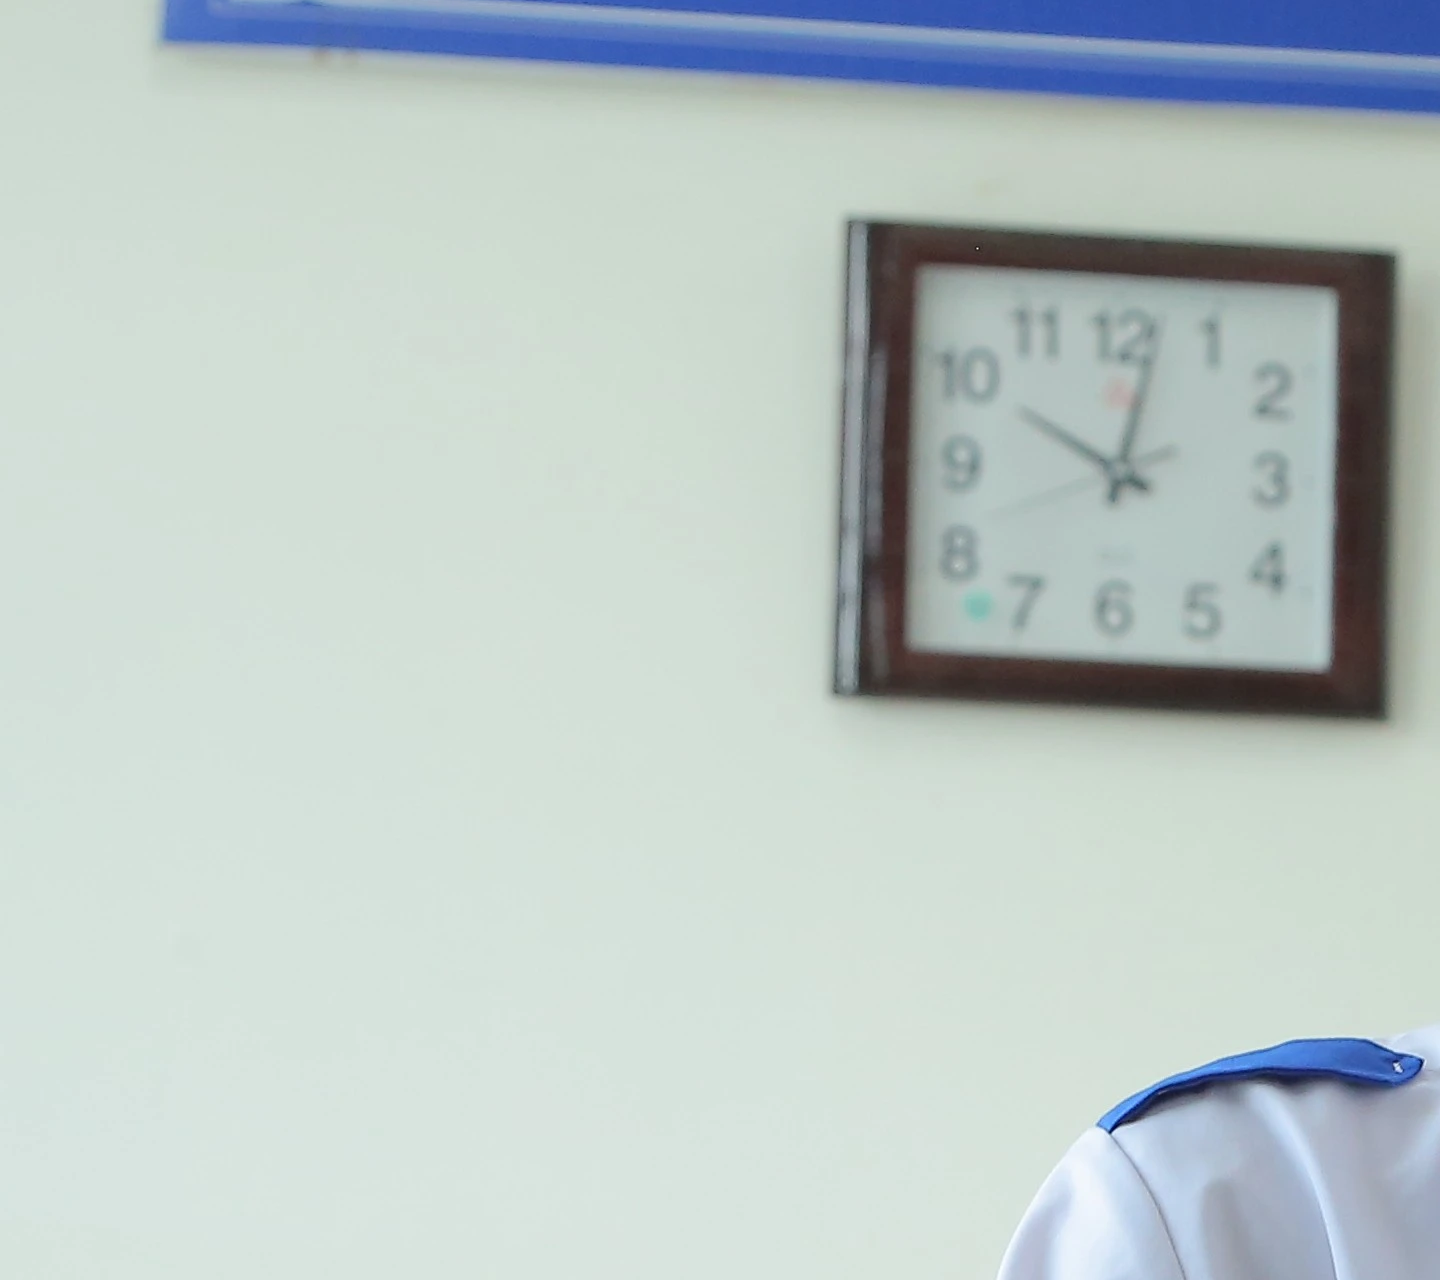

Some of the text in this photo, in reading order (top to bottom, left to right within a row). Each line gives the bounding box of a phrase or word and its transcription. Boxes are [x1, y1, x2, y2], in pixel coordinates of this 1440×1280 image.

[1012, 306, 1059, 360] 11
[1091, 308, 1157, 365] 12
[1201, 318, 1223, 370] 1
[937, 347, 1000, 404] 10
[1254, 362, 1293, 421] 2
[942, 434, 983, 494] 9
[1253, 450, 1292, 508] 3
[940, 524, 980, 583] 8
[1250, 543, 1287, 597] 4
[1007, 573, 1046, 631] 7
[1095, 579, 1134, 637] 6
[1182, 583, 1223, 641] 5
